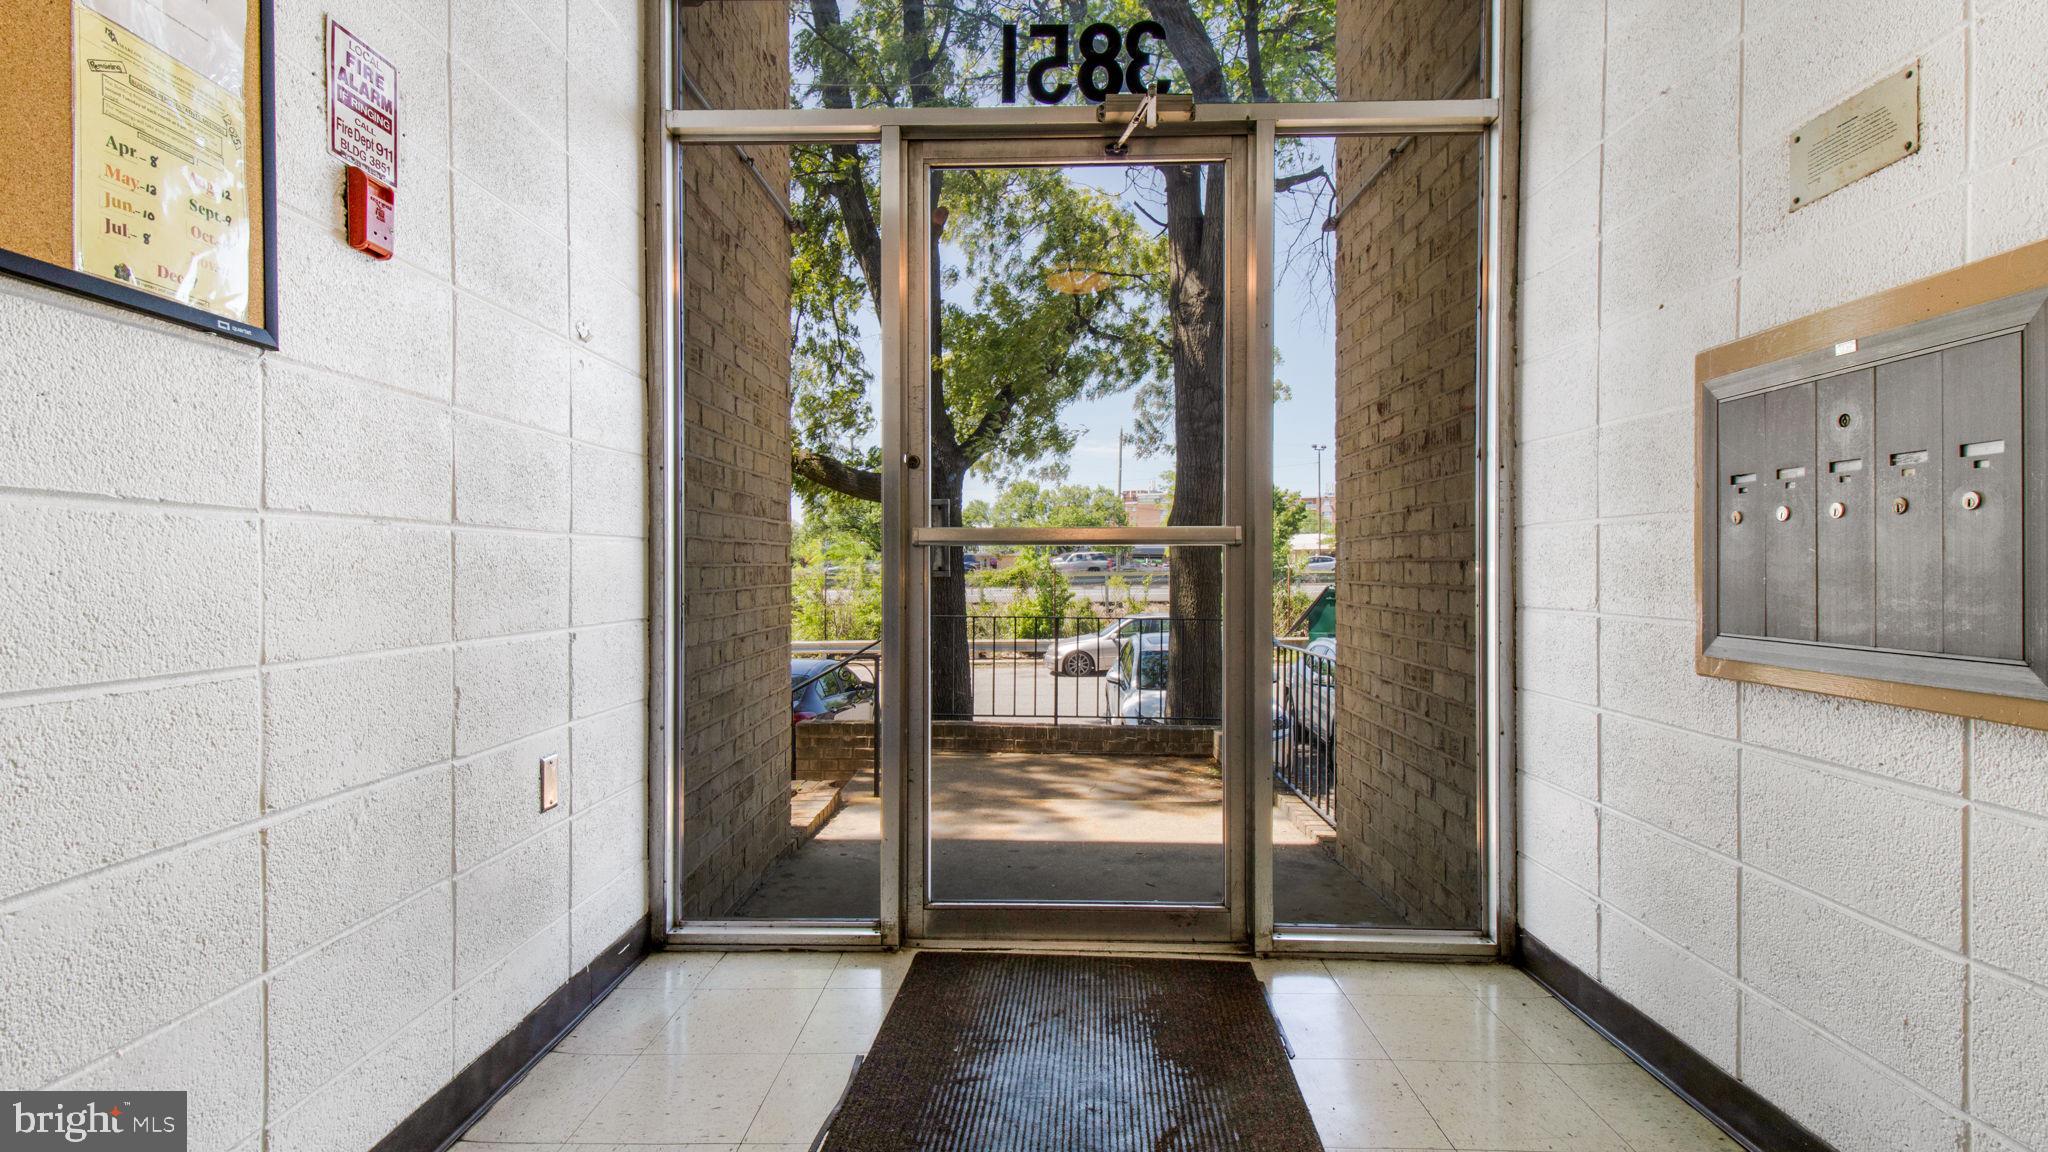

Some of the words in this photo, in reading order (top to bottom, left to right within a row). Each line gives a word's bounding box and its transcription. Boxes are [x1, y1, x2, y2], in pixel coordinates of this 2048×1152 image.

[346, 50, 385, 92] FIRE
[349, 40, 383, 72] LOCAL
[338, 66, 392, 116] ALARM
[351, 98, 390, 130] RINGING
[354, 118, 376, 137] CALL
[336, 116, 353, 138] Fire
[354, 128, 374, 152] Dept
[376, 142, 393, 163] 911
[150, 156, 158, 168] 8
[340, 138, 366, 162] BLDG
[369, 156, 390, 176] 3851
[143, 232, 151, 245] 8
